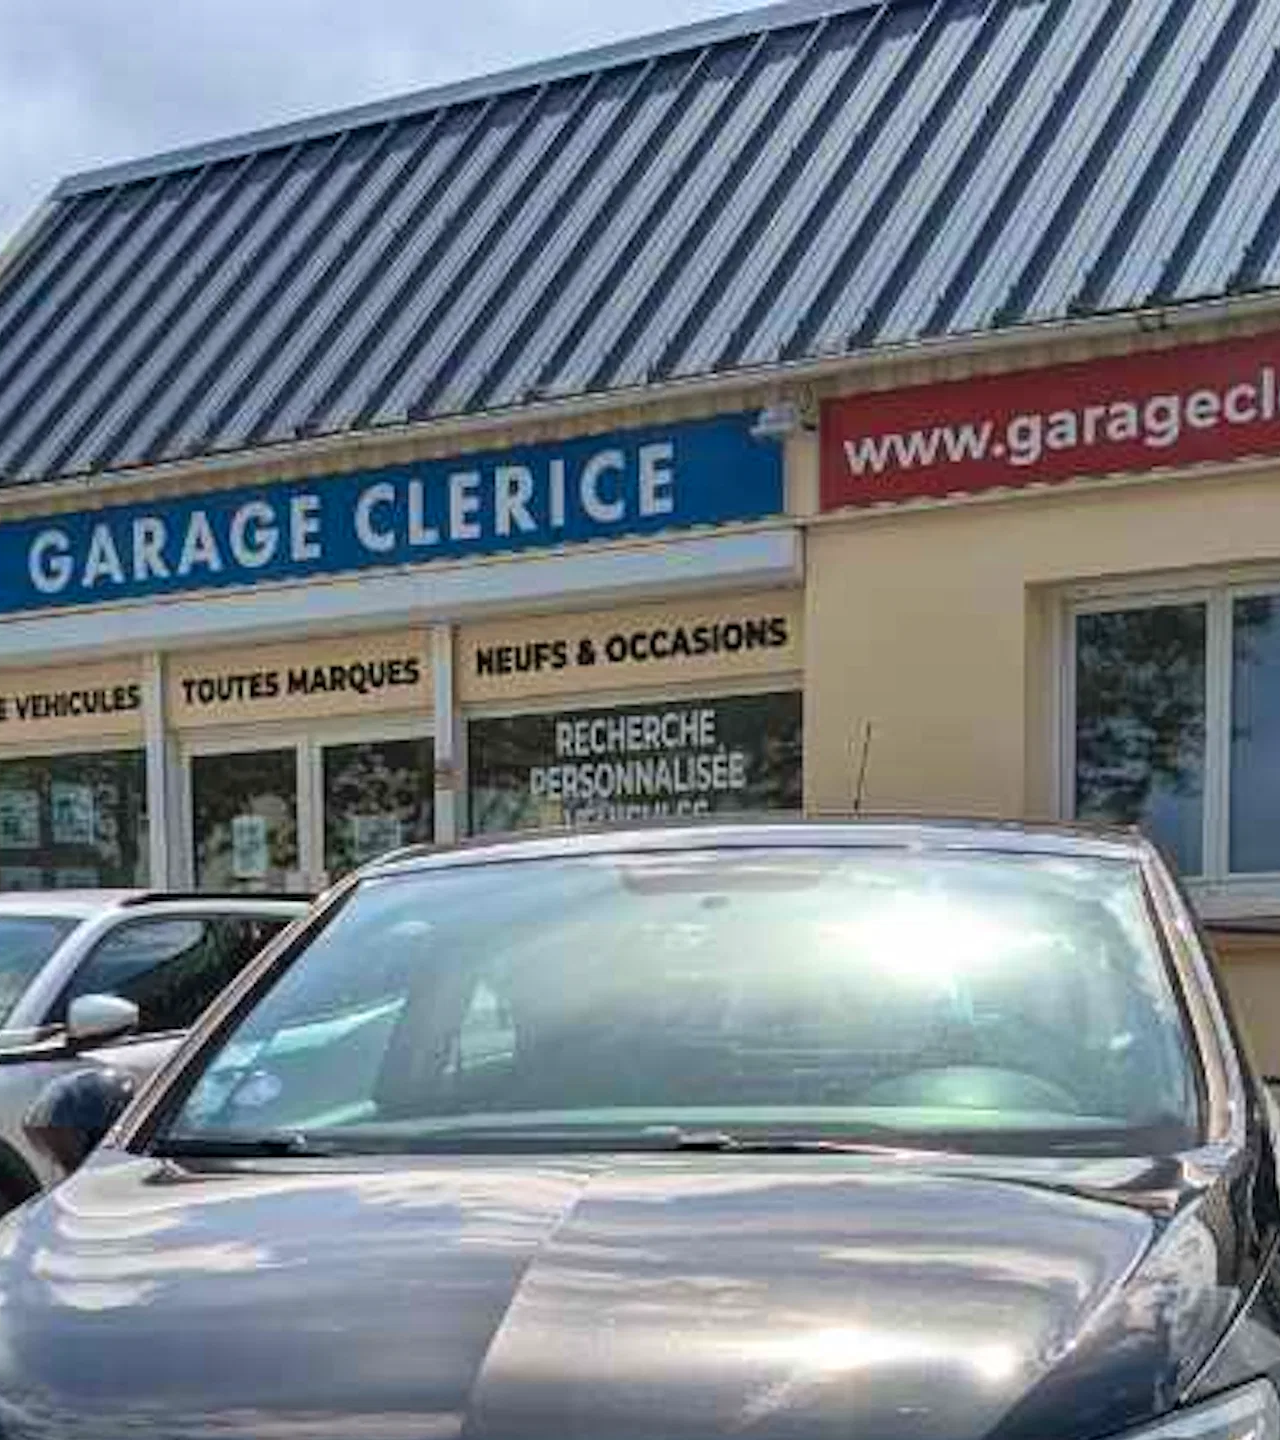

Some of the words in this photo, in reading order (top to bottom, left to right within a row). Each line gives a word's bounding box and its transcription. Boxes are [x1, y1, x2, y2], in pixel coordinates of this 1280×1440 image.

[27, 494, 321, 594] GARAGE
[354, 442, 676, 553] CLERICE
[477, 641, 567, 676] NEUFS
[577, 638, 596, 666] &
[605, 617, 788, 663] OCCASIONS
[16, 684, 141, 721] VEHICULES
[181, 672, 278, 705] TOUTES
[287, 657, 420, 695] MARQUES
[555, 708, 717, 757] RECHERCHE
